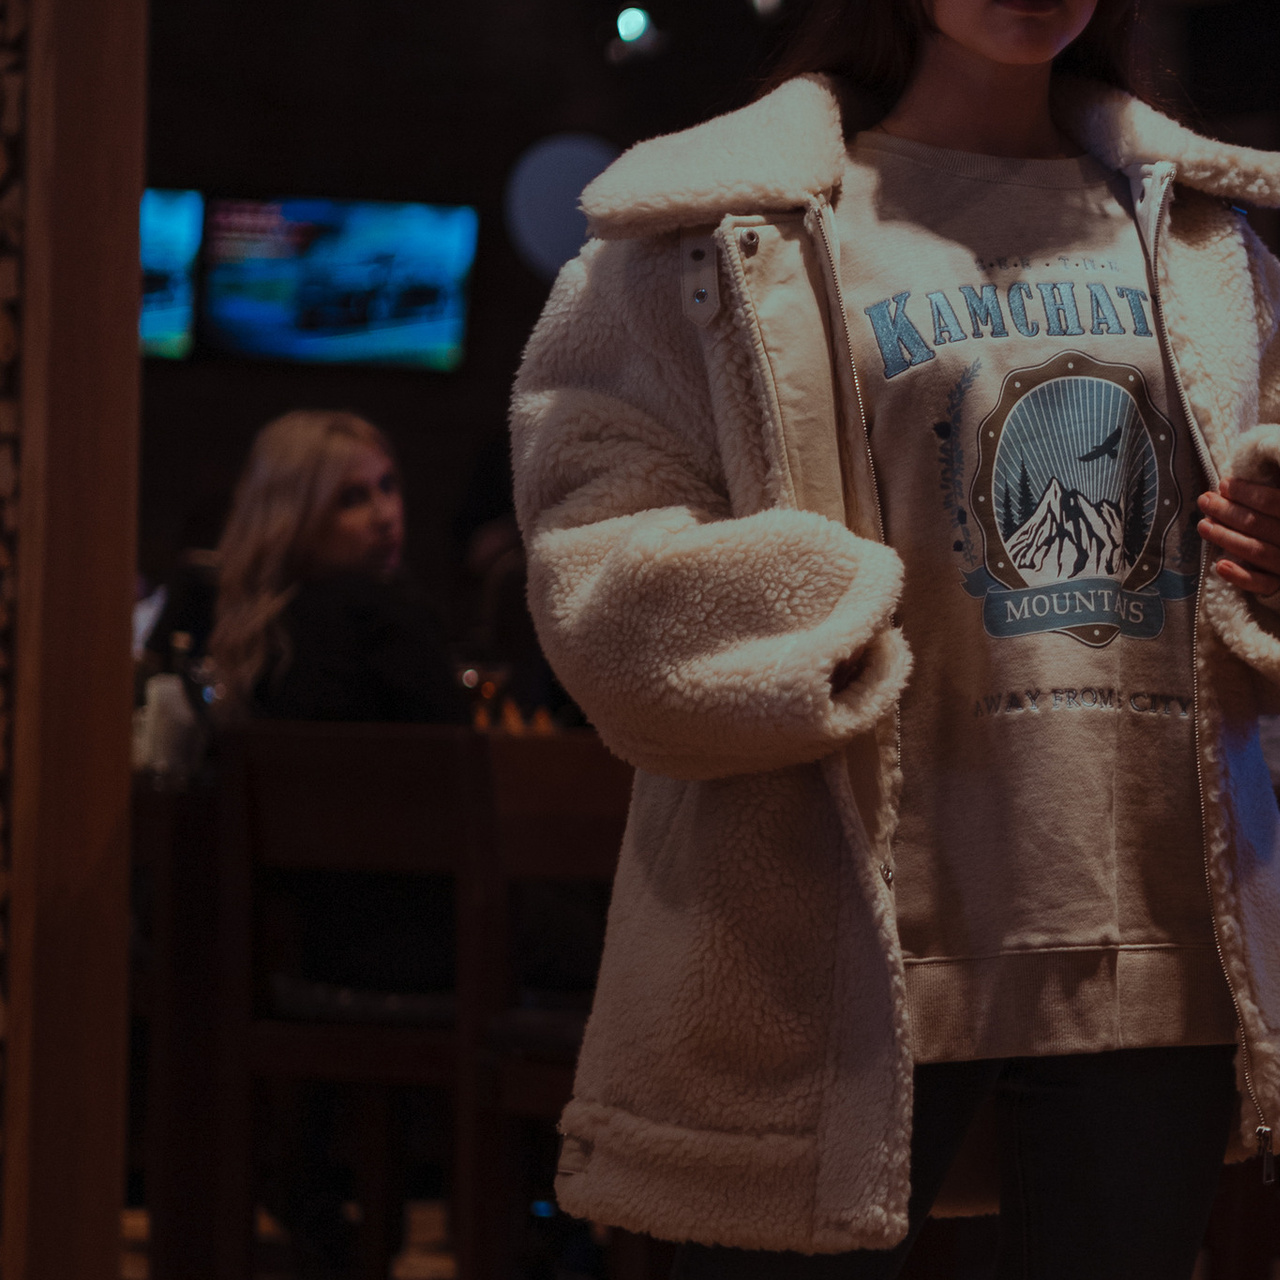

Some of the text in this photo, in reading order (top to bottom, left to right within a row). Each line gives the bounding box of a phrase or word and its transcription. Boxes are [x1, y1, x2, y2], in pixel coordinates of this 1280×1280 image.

[864, 282, 1153, 379] KAMCHAT
[974, 687, 1041, 718] AWAY
[1051, 687, 1114, 711] FROM
[1129, 692, 1193, 717] CITY
